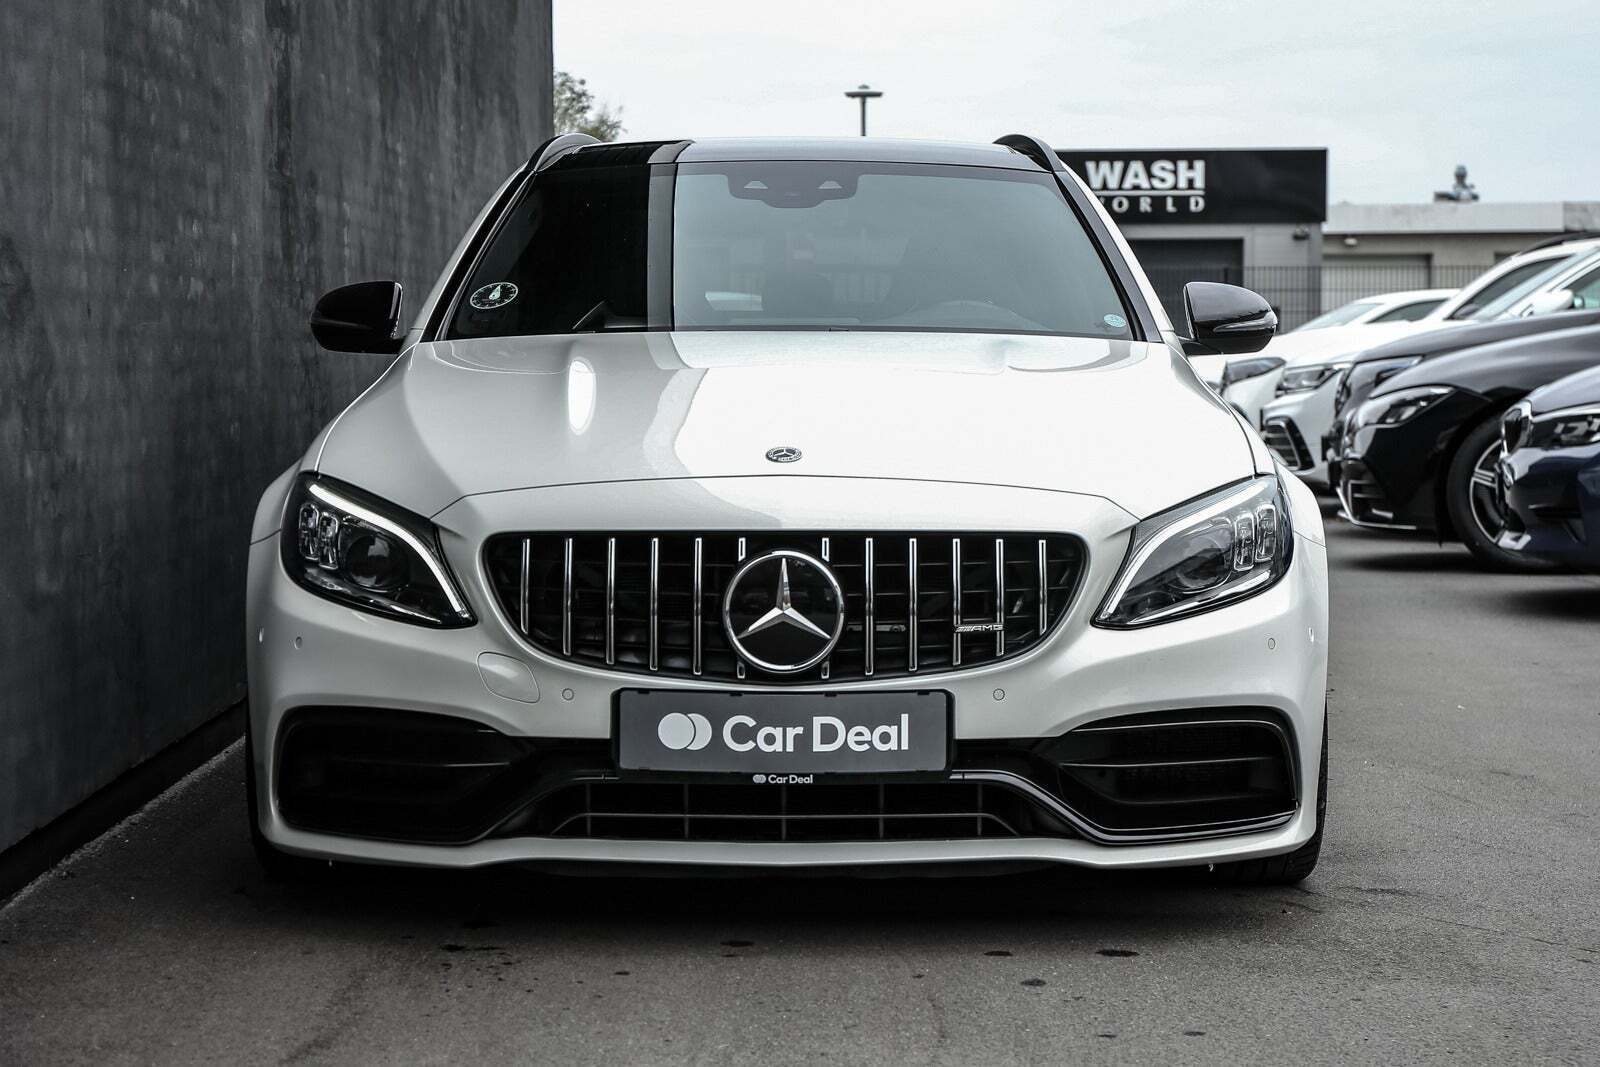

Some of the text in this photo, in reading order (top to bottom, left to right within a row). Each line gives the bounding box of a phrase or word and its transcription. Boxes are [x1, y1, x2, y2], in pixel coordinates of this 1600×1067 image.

[1085, 160, 1205, 189] WASH
[1099, 196, 1205, 213] ORLD
[723, 713, 909, 752] Car Deal
[768, 774, 813, 784] Car Deal
